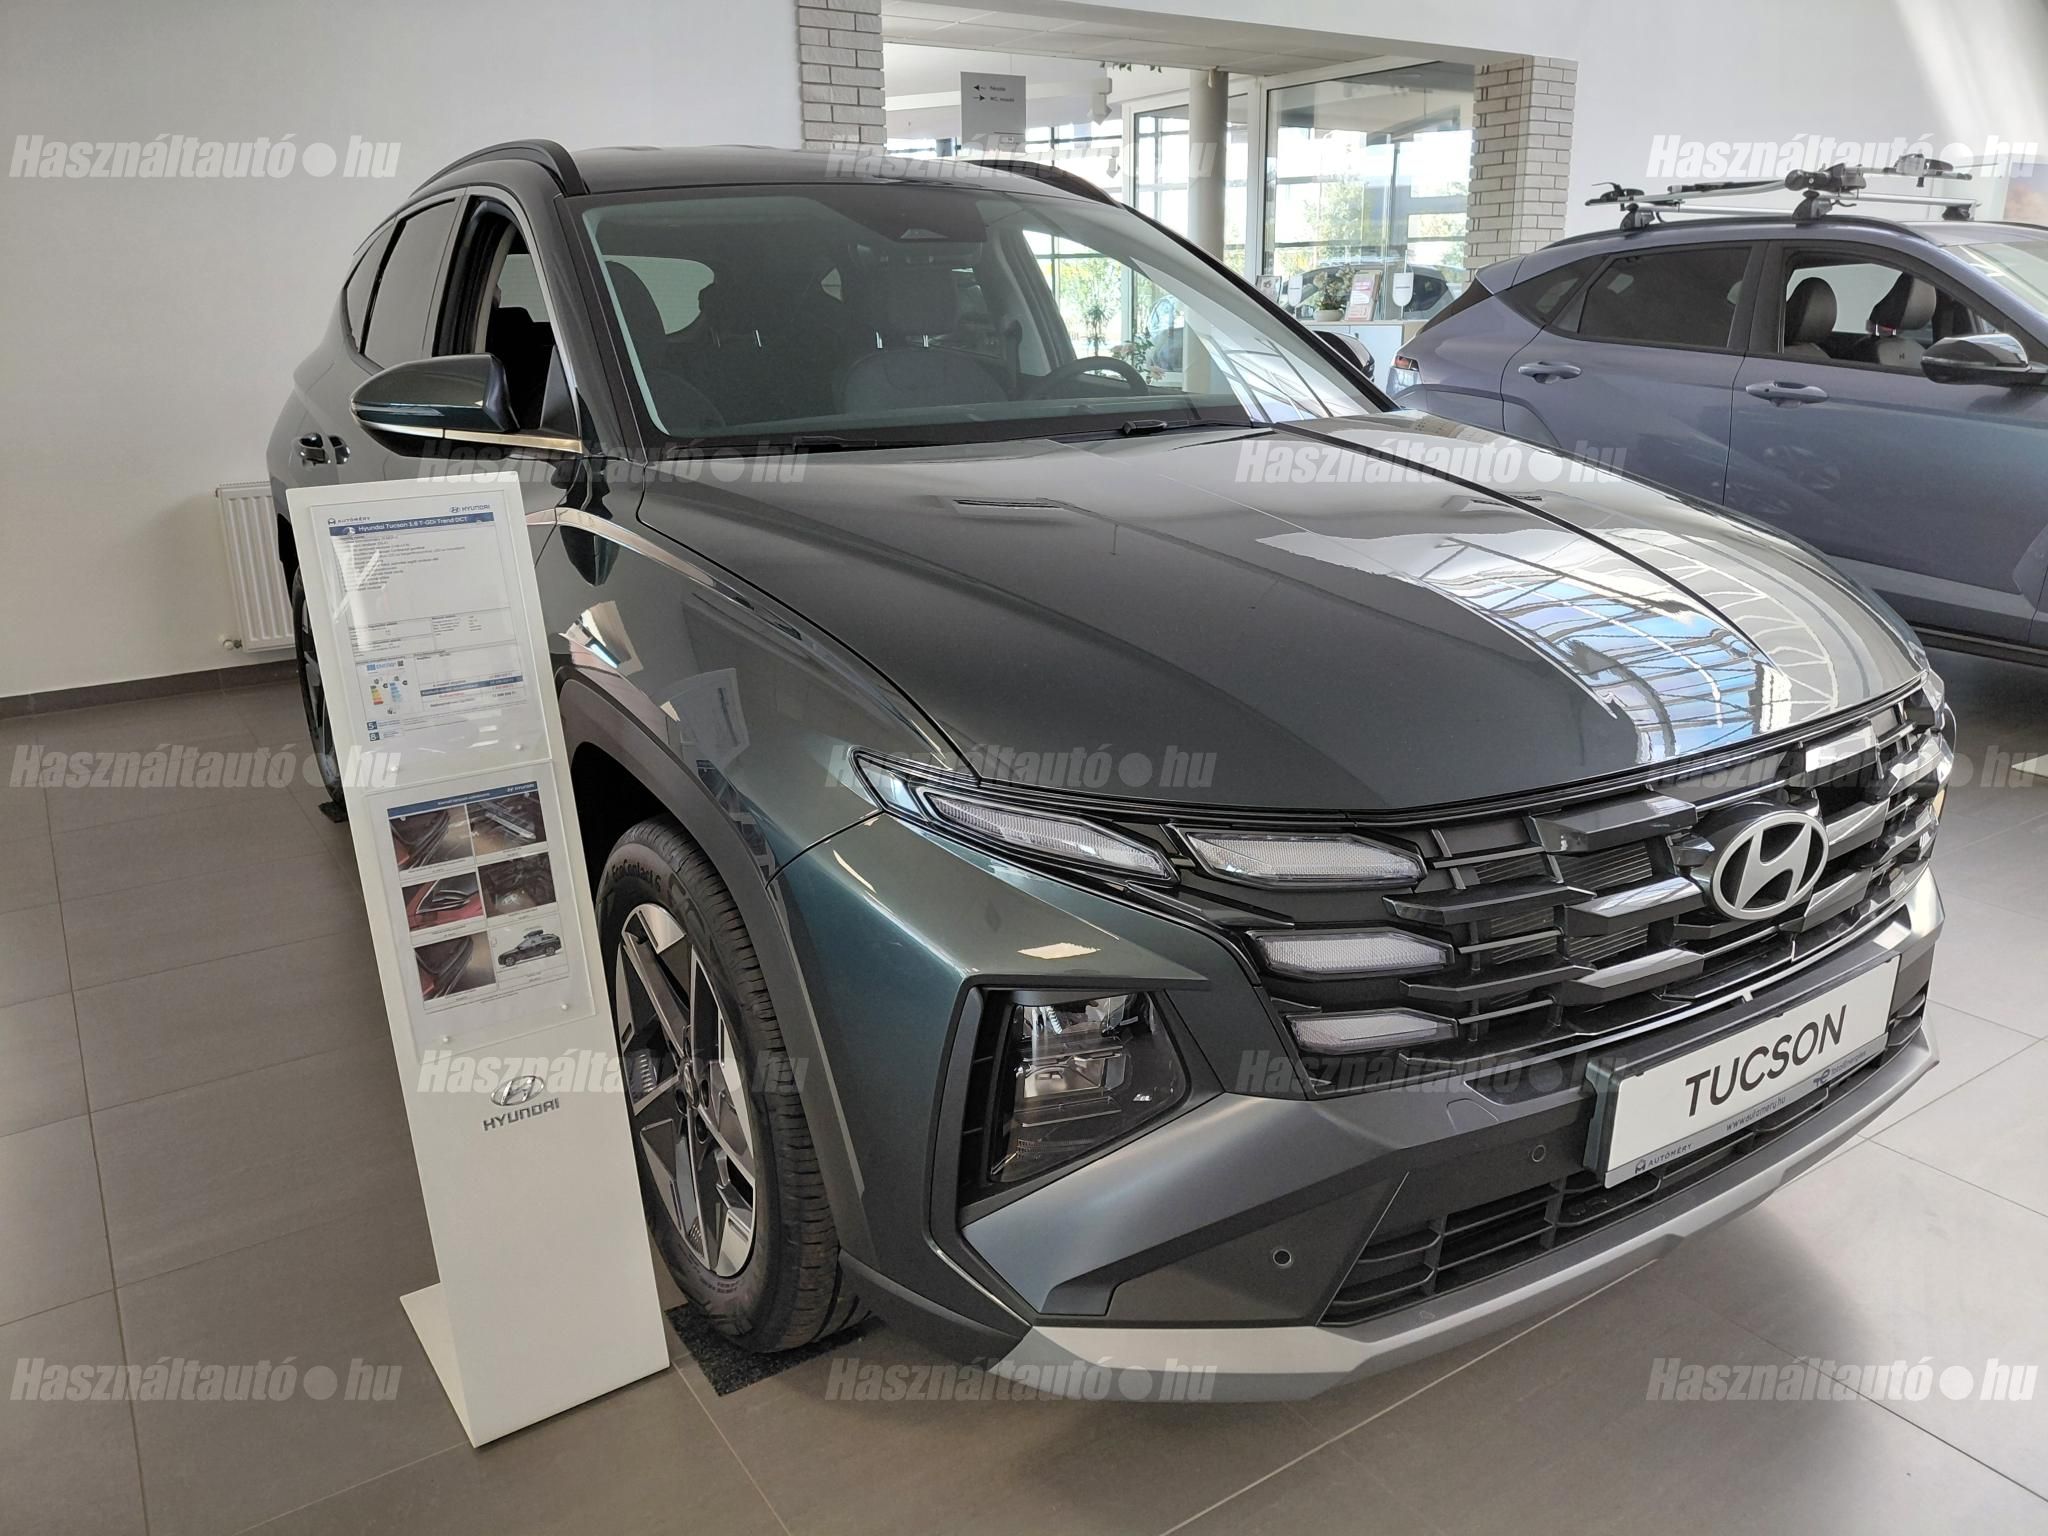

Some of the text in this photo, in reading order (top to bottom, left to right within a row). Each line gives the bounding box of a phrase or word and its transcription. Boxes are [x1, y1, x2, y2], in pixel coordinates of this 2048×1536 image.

[358, 523, 385, 532] Hyundai
[1685, 1004, 1847, 1117] TUCSON
[483, 1097, 560, 1131] HYUNDAI
